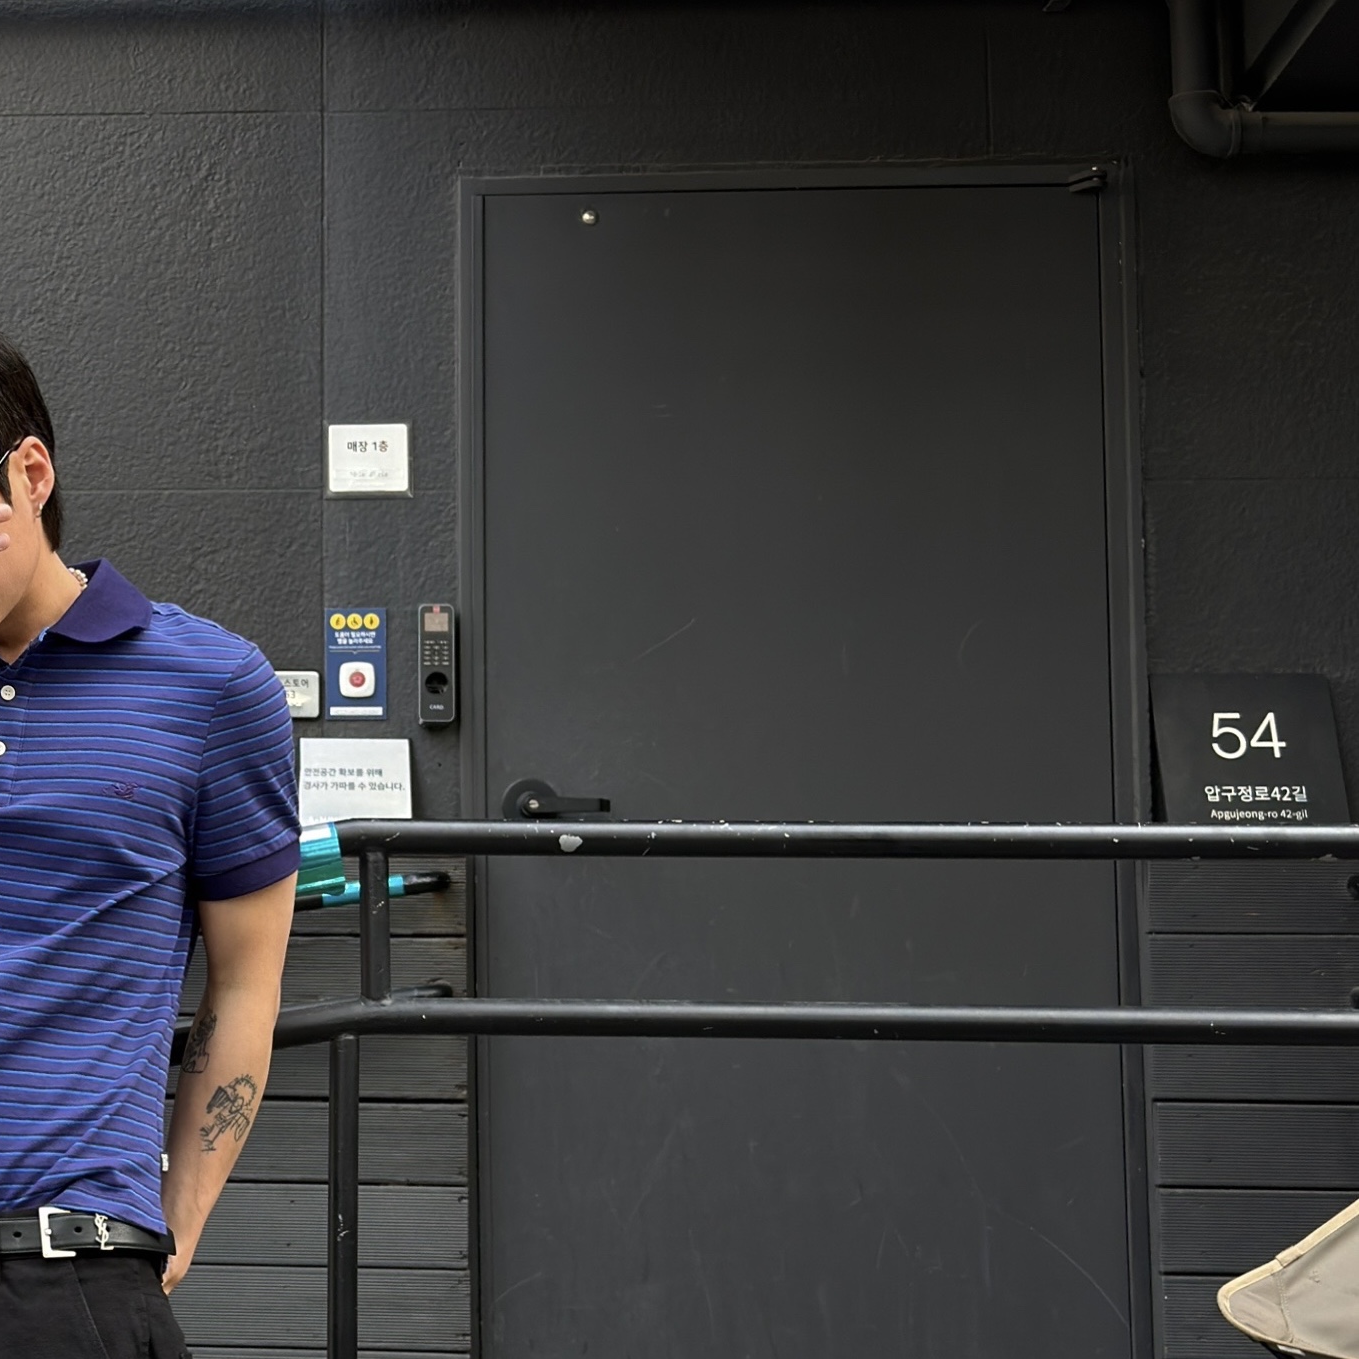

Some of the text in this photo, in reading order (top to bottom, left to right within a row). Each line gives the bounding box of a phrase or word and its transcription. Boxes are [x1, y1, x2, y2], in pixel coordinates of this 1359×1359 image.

[347, 441, 388, 452] 매장 1층
[1211, 712, 1287, 759] 54
[304, 768, 383, 777] 안전공간 확보를 위해
[357, 782, 367, 791] 수
[368, 782, 406, 791] 있습니다.
[1204, 785, 1308, 802] 압구정로42길
[1210, 809, 1308, 821] Apgujeong-ro 42-gil
